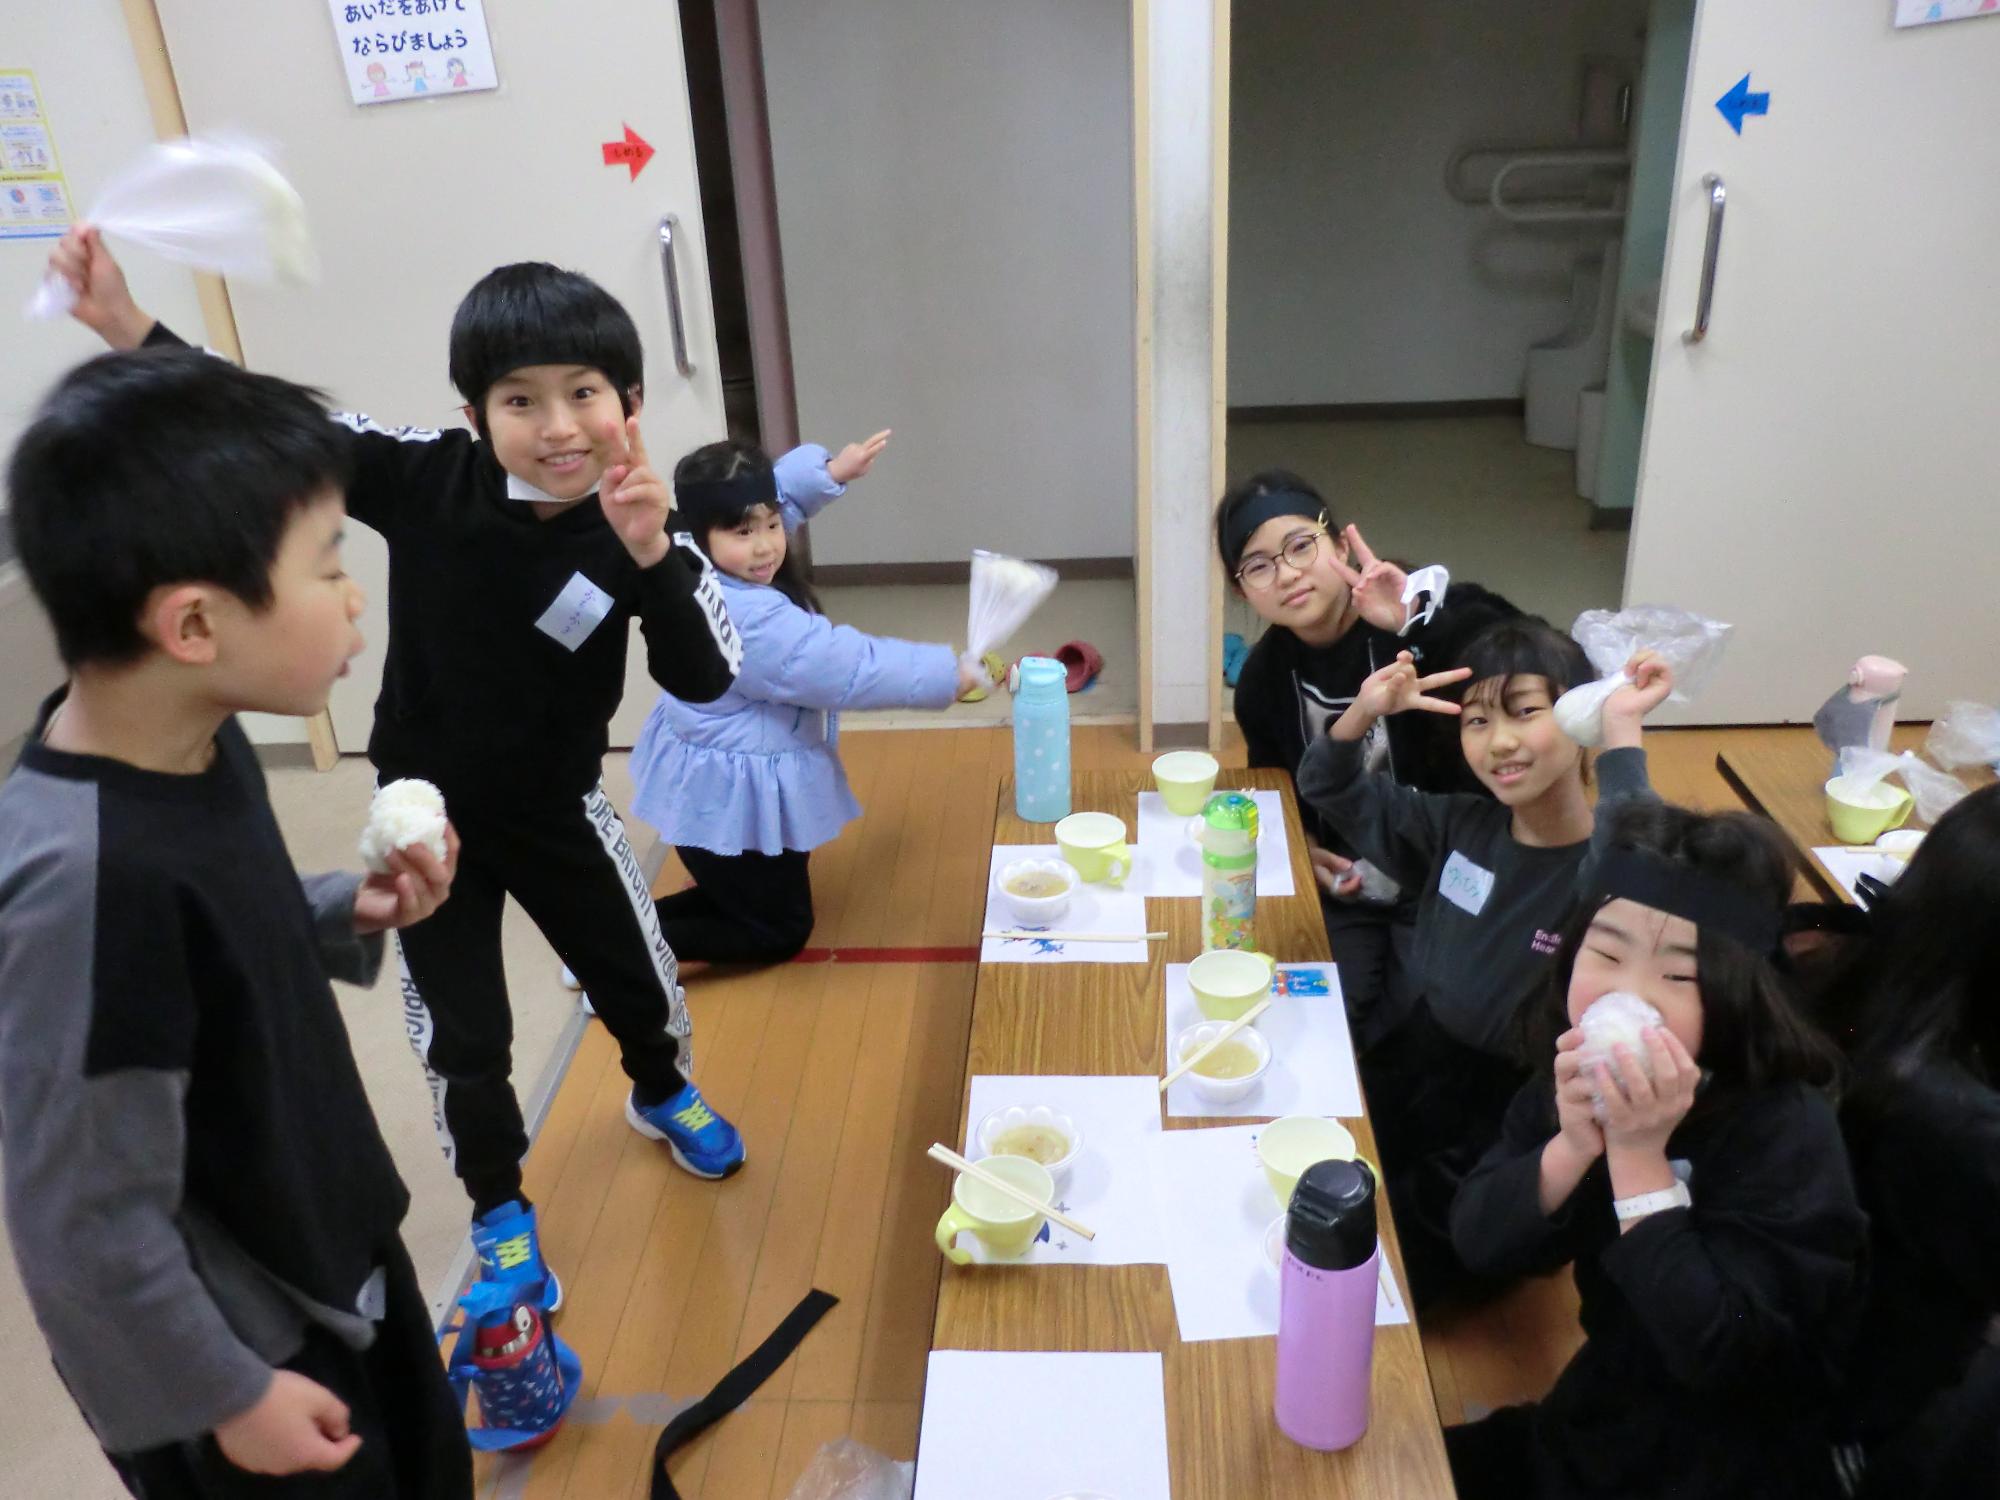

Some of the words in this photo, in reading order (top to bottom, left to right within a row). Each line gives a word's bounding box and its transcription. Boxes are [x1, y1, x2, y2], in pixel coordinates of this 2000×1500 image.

[352, 29, 468, 56] ならびましょう
